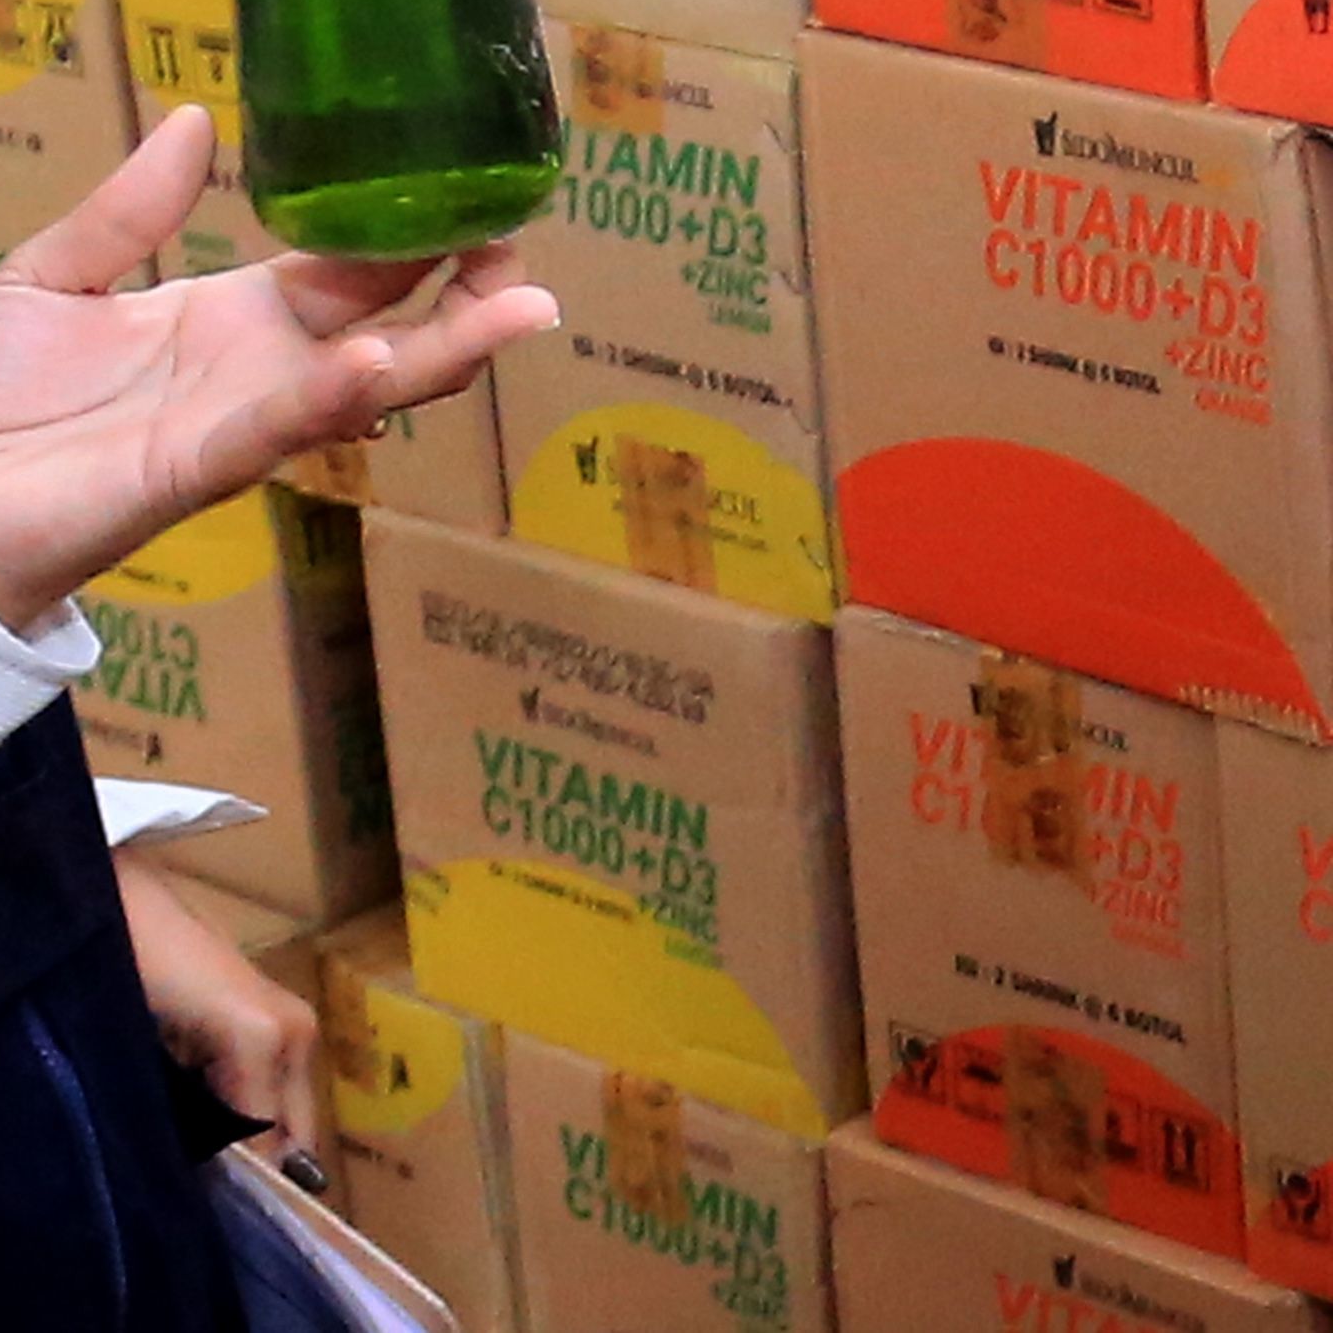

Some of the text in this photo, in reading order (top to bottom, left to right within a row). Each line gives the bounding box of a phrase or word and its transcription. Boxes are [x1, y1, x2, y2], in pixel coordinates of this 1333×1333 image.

[978, 159, 1261, 282] VITAMIN
[681, 259, 770, 306] +ZINC
[984, 228, 1268, 348] C1000+D3
[1164, 337, 1271, 394] +ZINC
[473, 726, 708, 852] VITAMIN
[481, 784, 718, 907] C1000+D3
